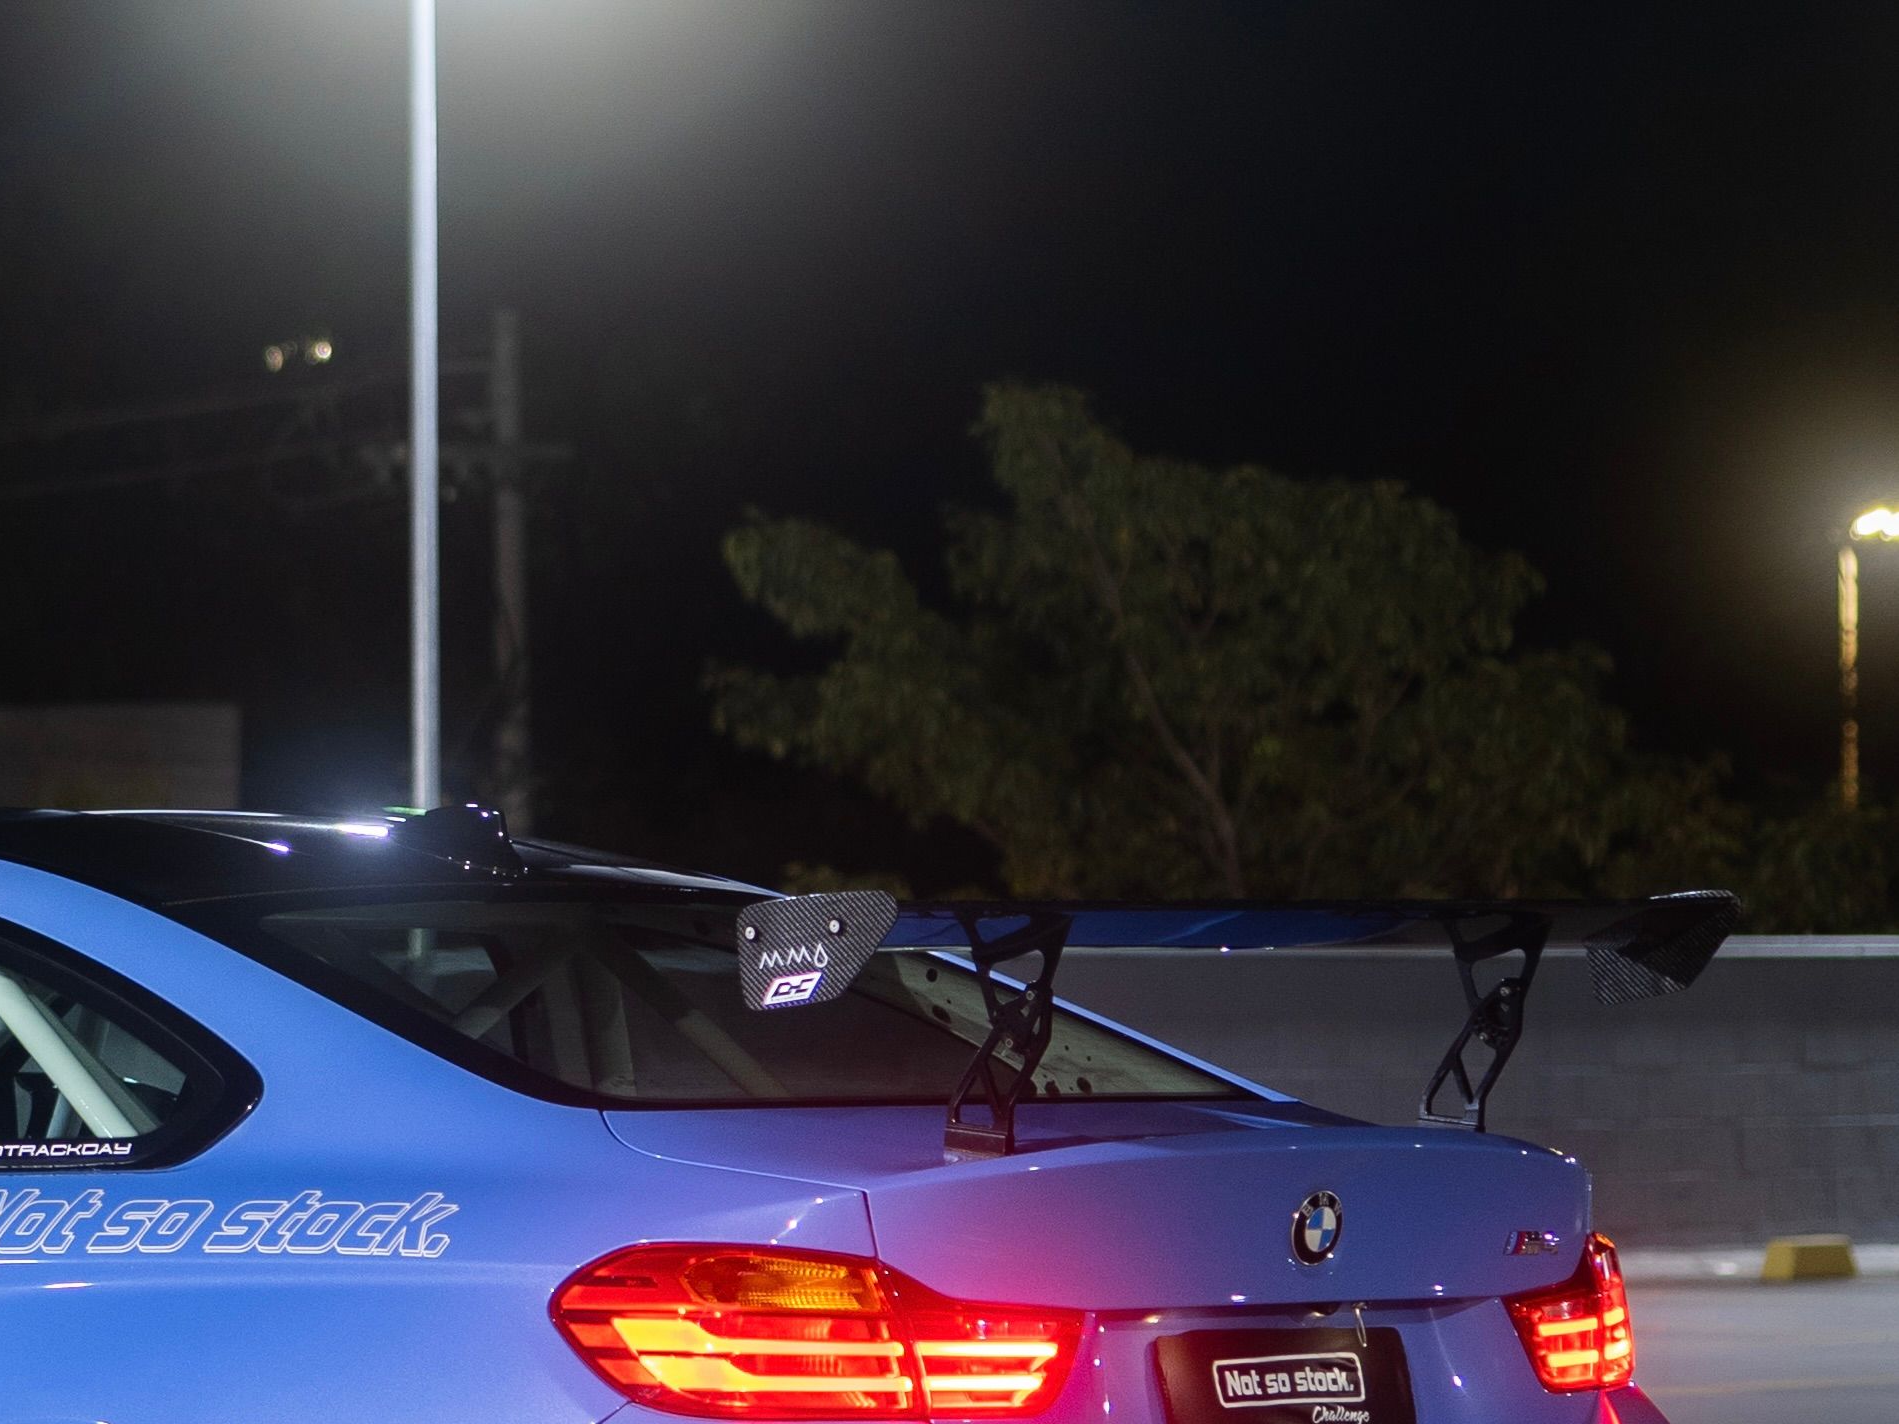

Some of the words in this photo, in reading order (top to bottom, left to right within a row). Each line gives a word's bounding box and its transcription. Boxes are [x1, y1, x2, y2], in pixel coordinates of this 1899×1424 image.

[85, 1199, 215, 1254] so
[202, 1189, 460, 1258] stock.
[1225, 1369, 1262, 1397] Not
[1264, 1372, 1292, 1394] so
[1294, 1366, 1354, 1392] stock.
